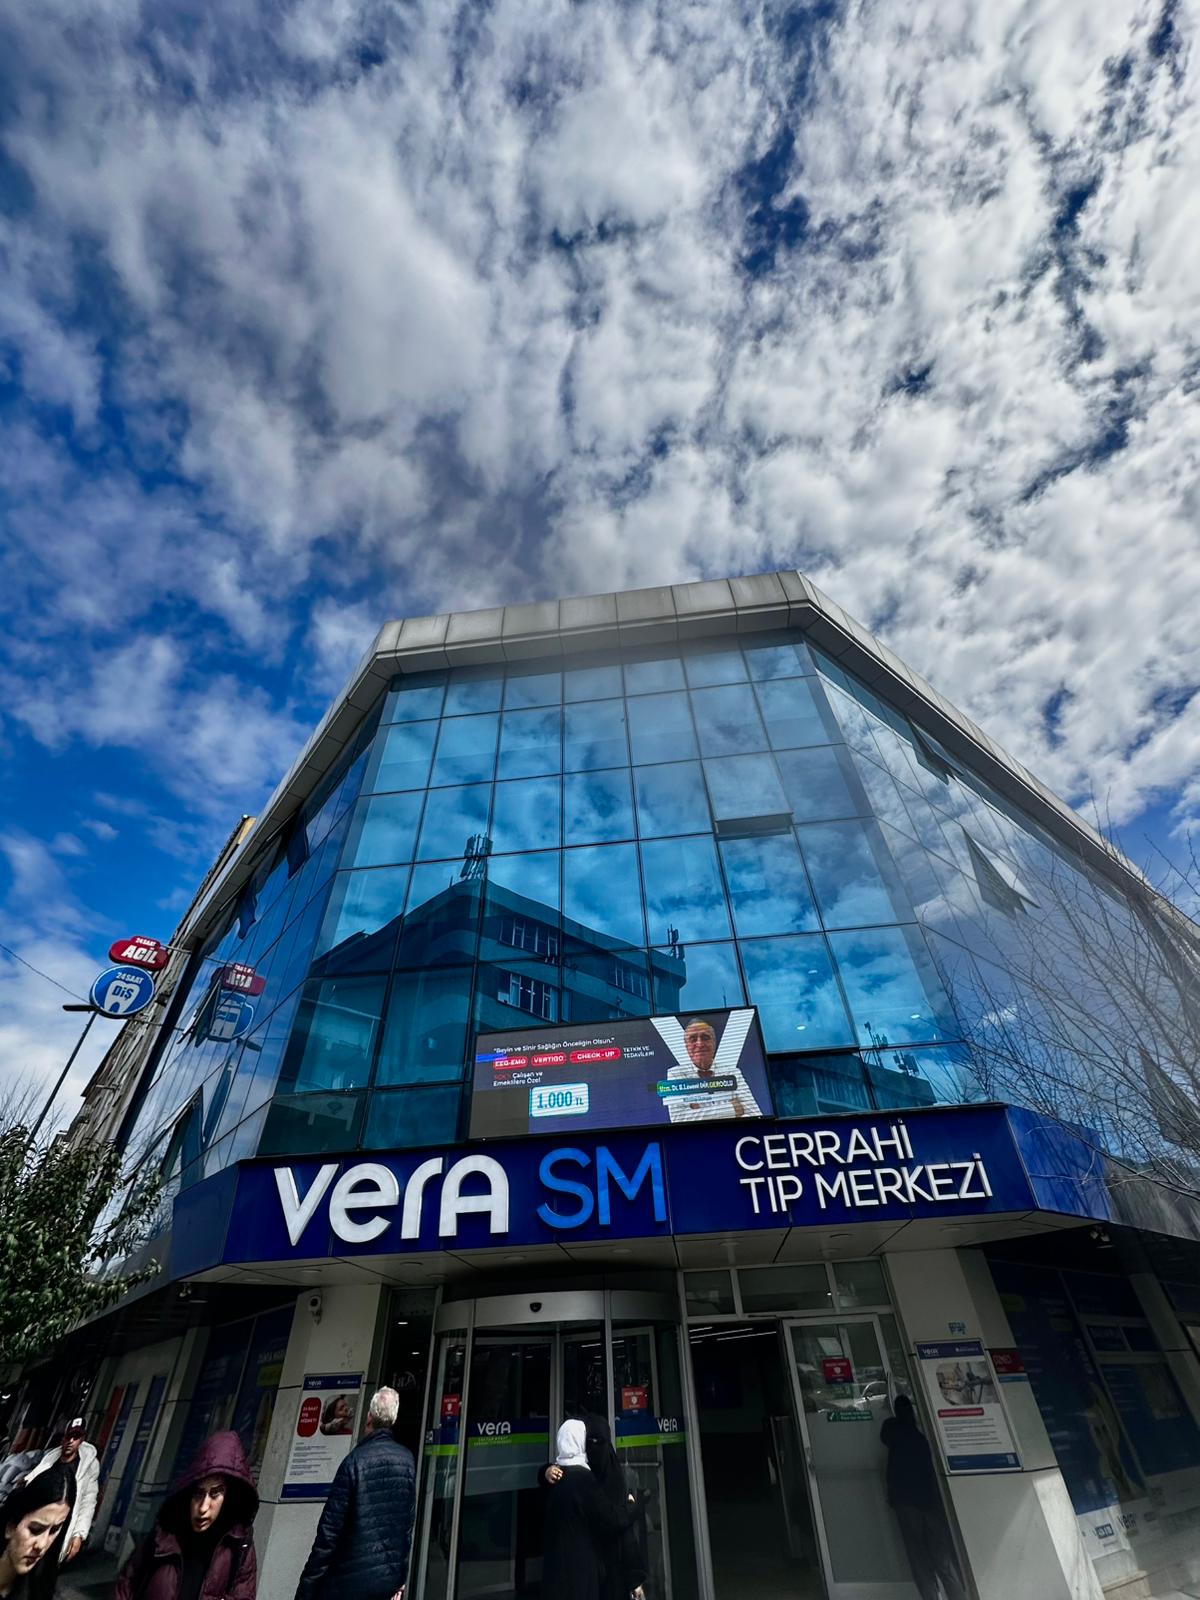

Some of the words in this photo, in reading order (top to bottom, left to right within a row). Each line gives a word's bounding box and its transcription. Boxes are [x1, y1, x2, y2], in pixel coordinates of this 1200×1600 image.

[121, 944, 158, 964] ACİL
[112, 985, 134, 1000] DİŞ
[537, 1091, 573, 1109] 1.000
[735, 1118, 914, 1170] CERRAHİ
[536, 1142, 668, 1229] SM
[740, 1175, 803, 1214] TIP
[814, 1152, 993, 1209] MERKEZİ
